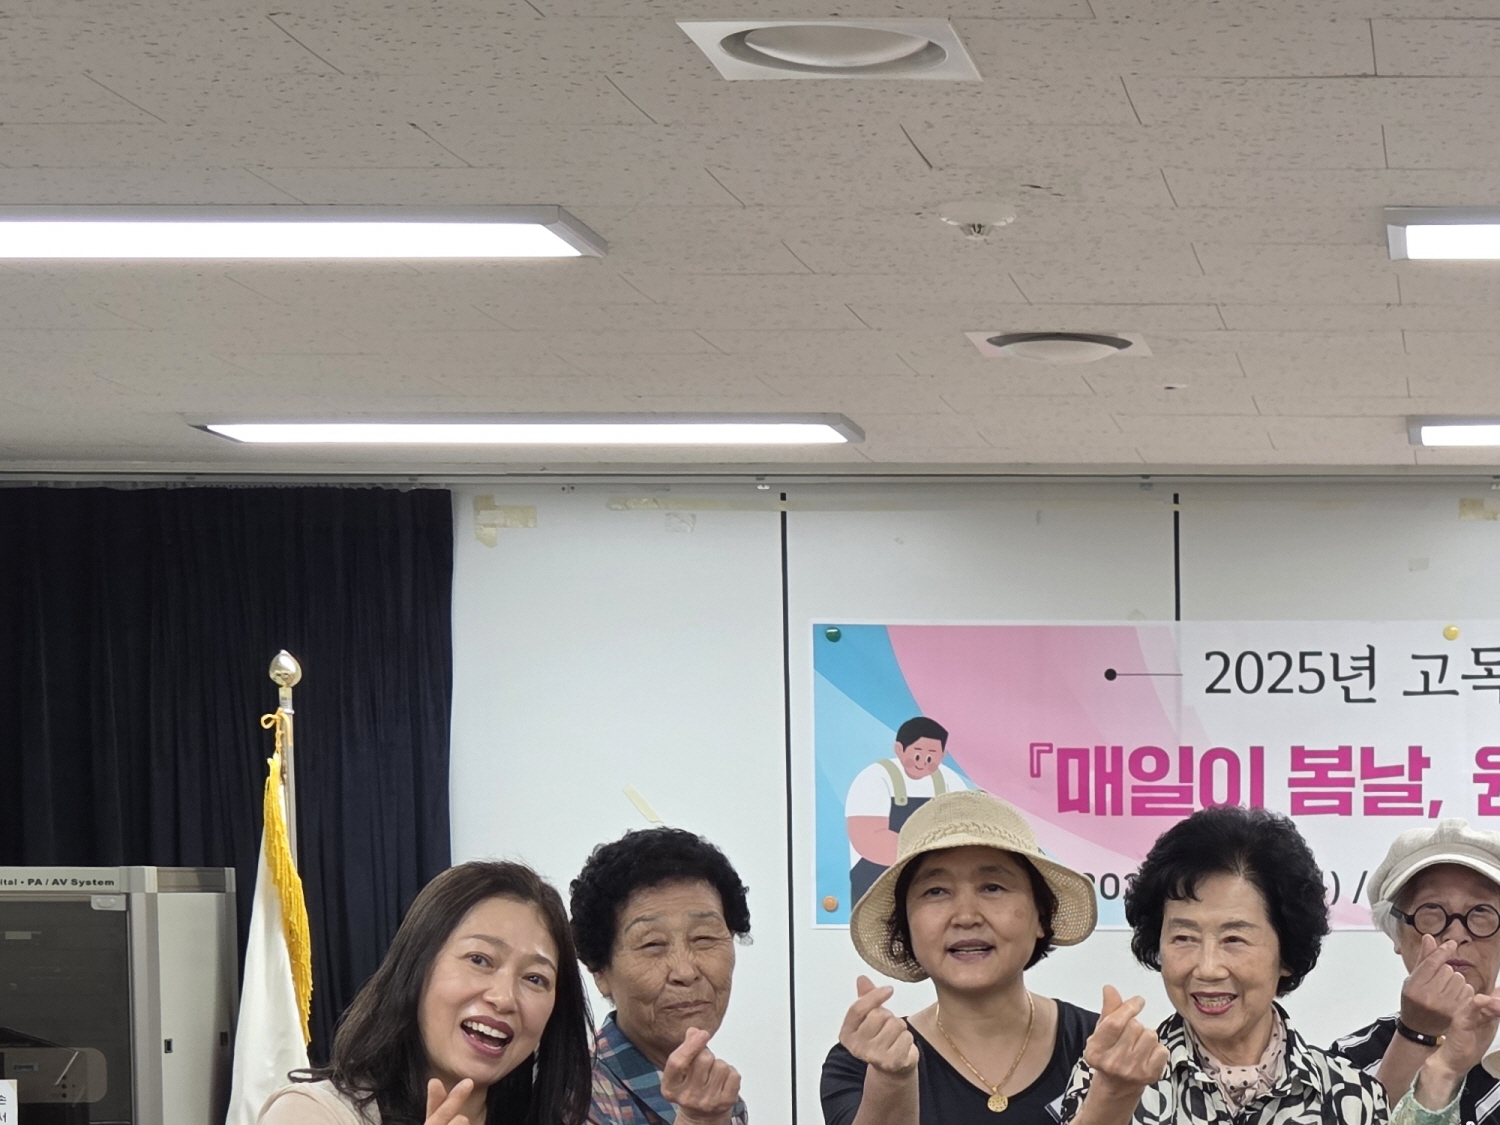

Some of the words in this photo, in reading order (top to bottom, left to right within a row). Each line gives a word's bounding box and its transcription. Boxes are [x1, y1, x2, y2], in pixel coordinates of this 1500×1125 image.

[1204, 643, 1377, 705] 2025년
[1287, 745, 1444, 818] 봄날,
[27, 878, 43, 886] PA
[51, 878, 68, 886] AV
[70, 878, 115, 888] System
